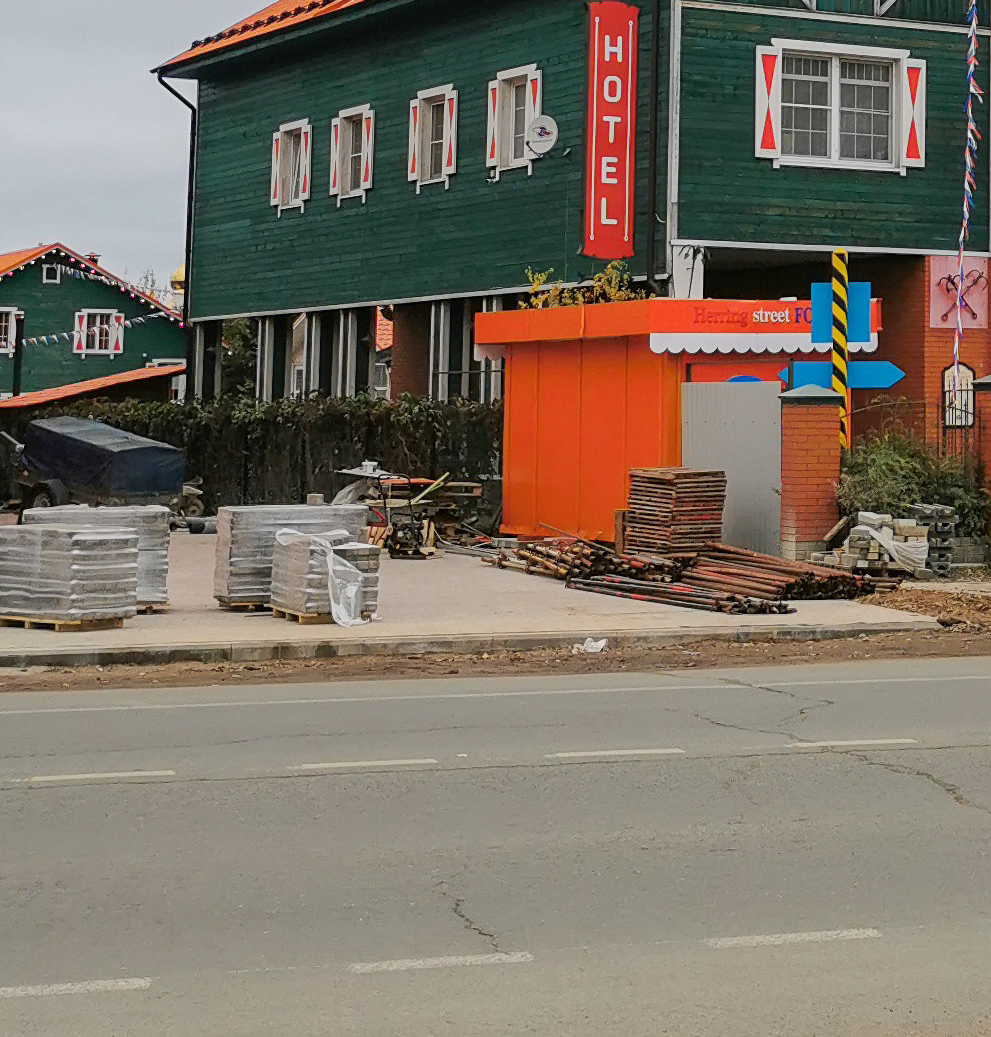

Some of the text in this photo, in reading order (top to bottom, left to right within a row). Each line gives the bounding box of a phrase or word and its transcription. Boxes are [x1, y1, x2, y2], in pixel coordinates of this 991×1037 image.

[600, 34, 623, 225] HOTEL
[693, 306, 749, 327] Herring
[752, 307, 790, 323] street
